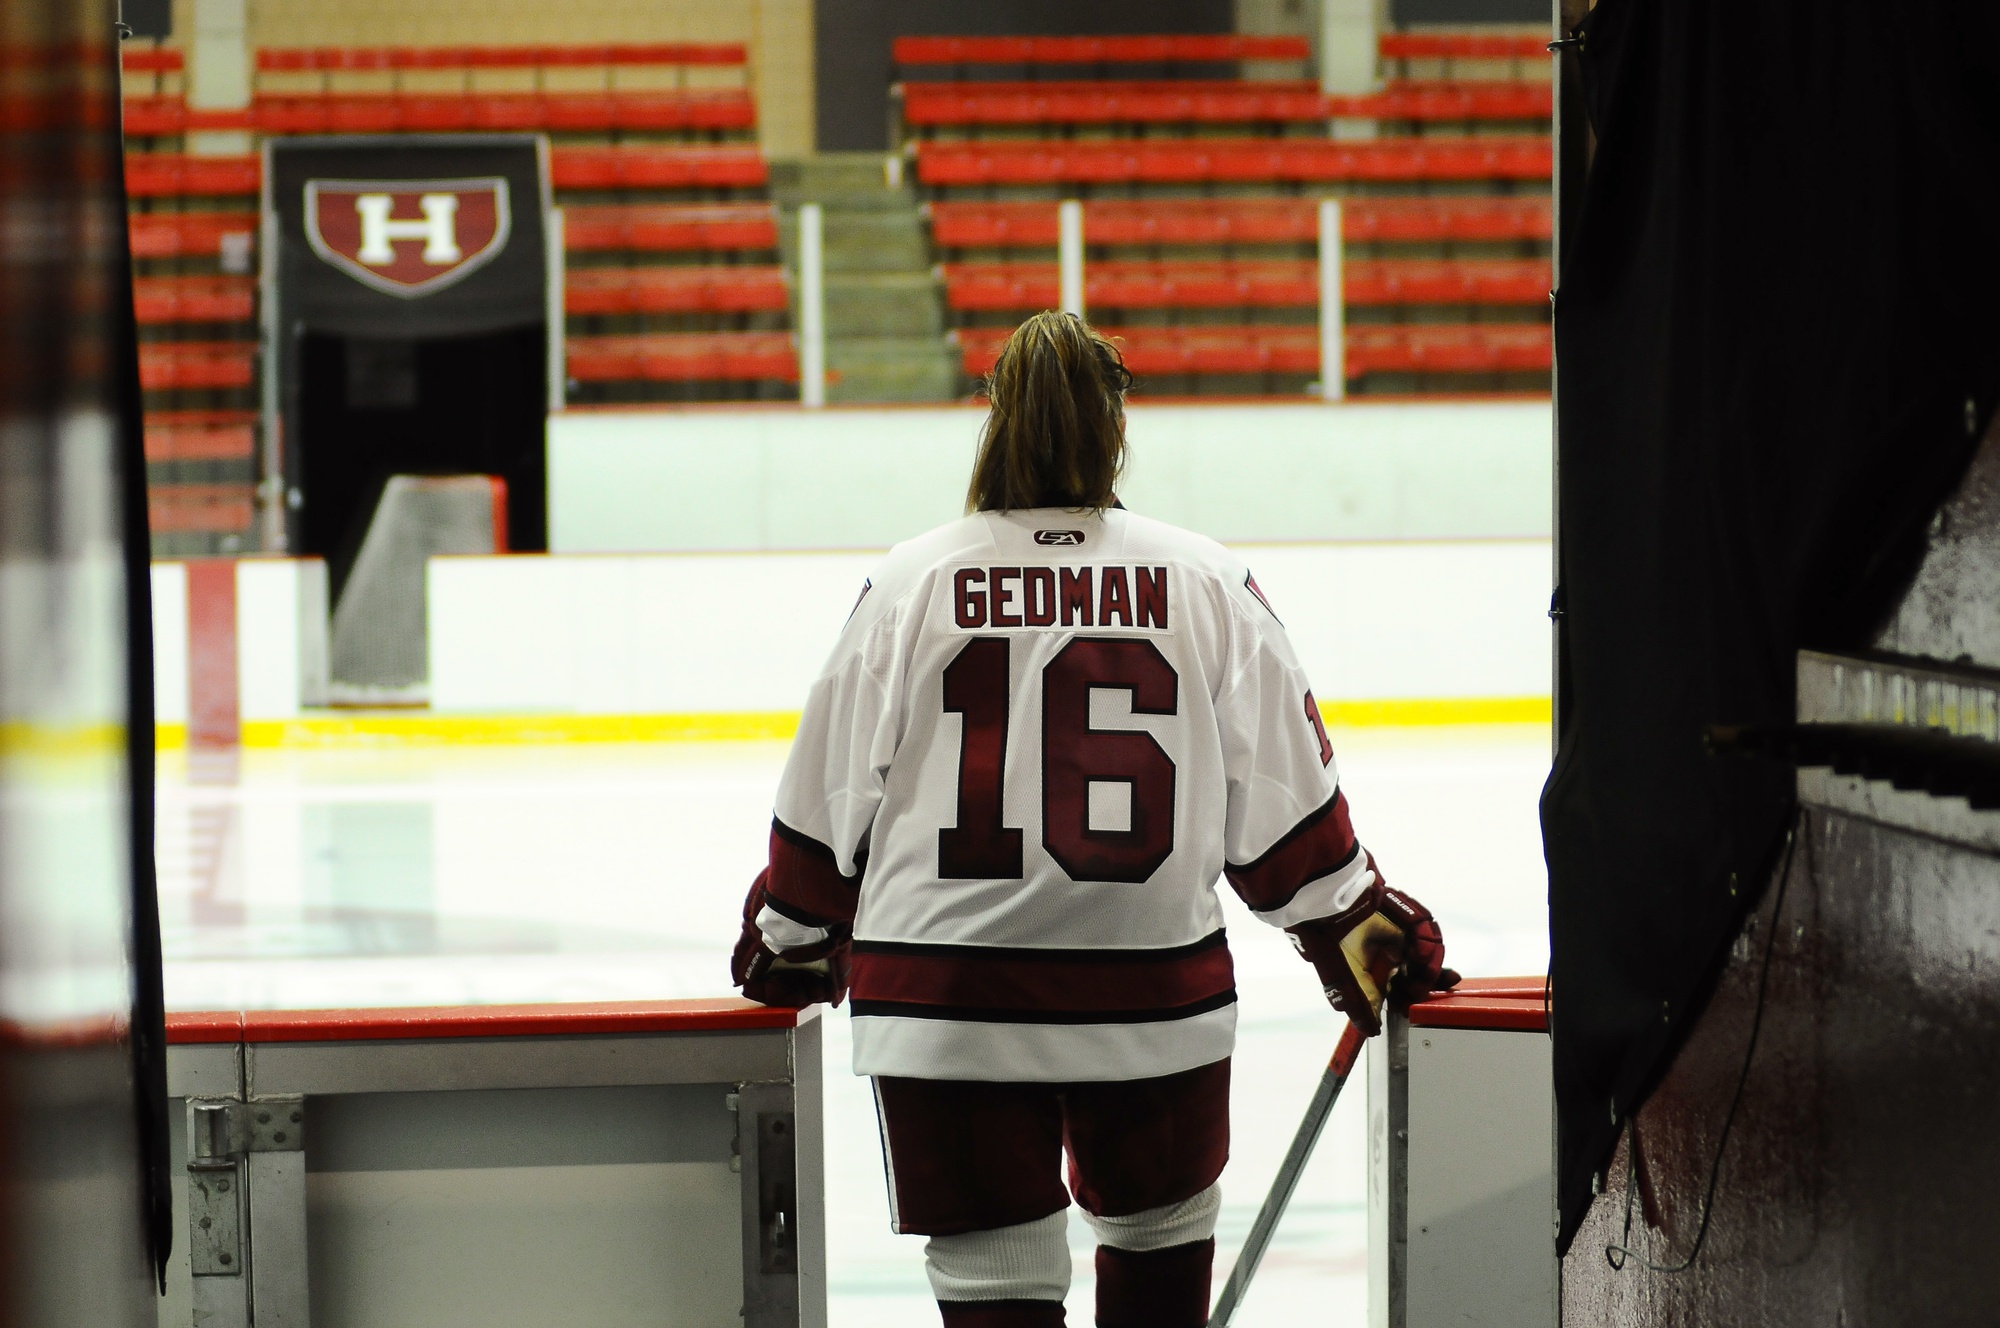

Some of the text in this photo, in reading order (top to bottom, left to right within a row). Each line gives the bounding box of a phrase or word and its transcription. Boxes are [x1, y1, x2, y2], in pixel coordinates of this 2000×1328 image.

[356, 193, 461, 265] H
[954, 566, 1168, 629] GEDMAN
[938, 636, 1179, 884] 16
